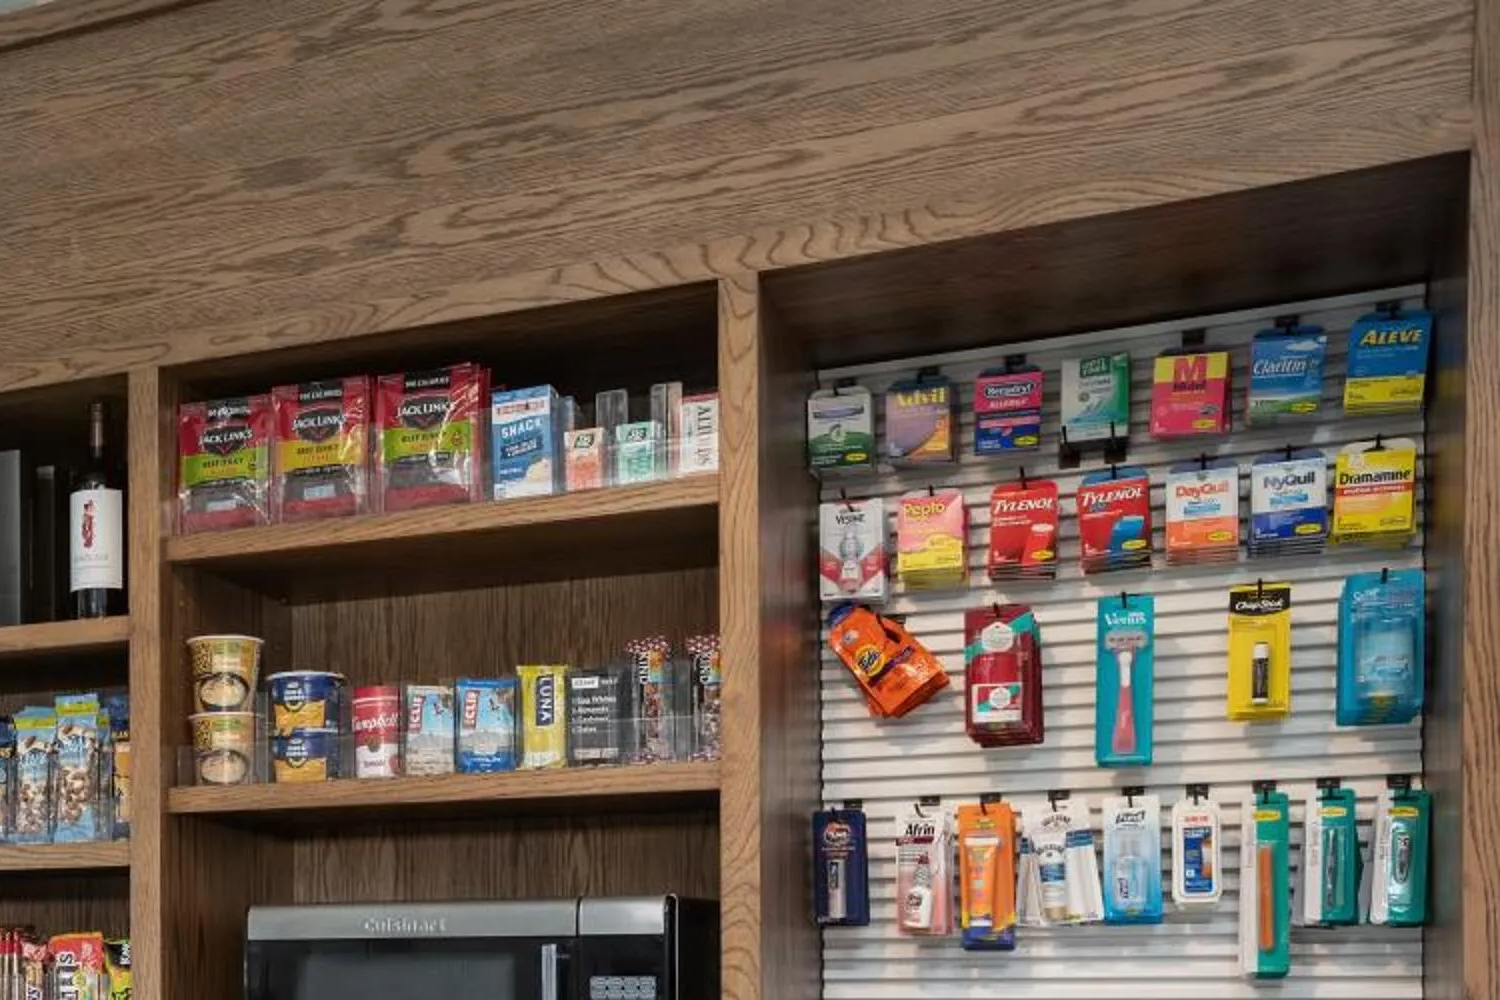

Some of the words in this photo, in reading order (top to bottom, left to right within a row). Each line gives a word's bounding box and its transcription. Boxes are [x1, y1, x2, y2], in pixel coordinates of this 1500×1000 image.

[1360, 328, 1423, 346] ALEVE
[1252, 357, 1308, 376] Claritin
[897, 387, 945, 406] Advil
[985, 383, 1032, 397] Benadryl
[1263, 471, 1315, 491] NyQuil
[1339, 469, 1410, 485] Dramamine
[1081, 485, 1143, 506] TYLENOL
[1175, 480, 1229, 499] DayQuil
[903, 501, 946, 517] Pepto
[994, 497, 1053, 513] TYLENOL
[1104, 611, 1147, 626] Venus
[538, 676, 554, 722] LUNA
[905, 823, 935, 836] Afrin
[362, 916, 448, 933] Cuisinart
